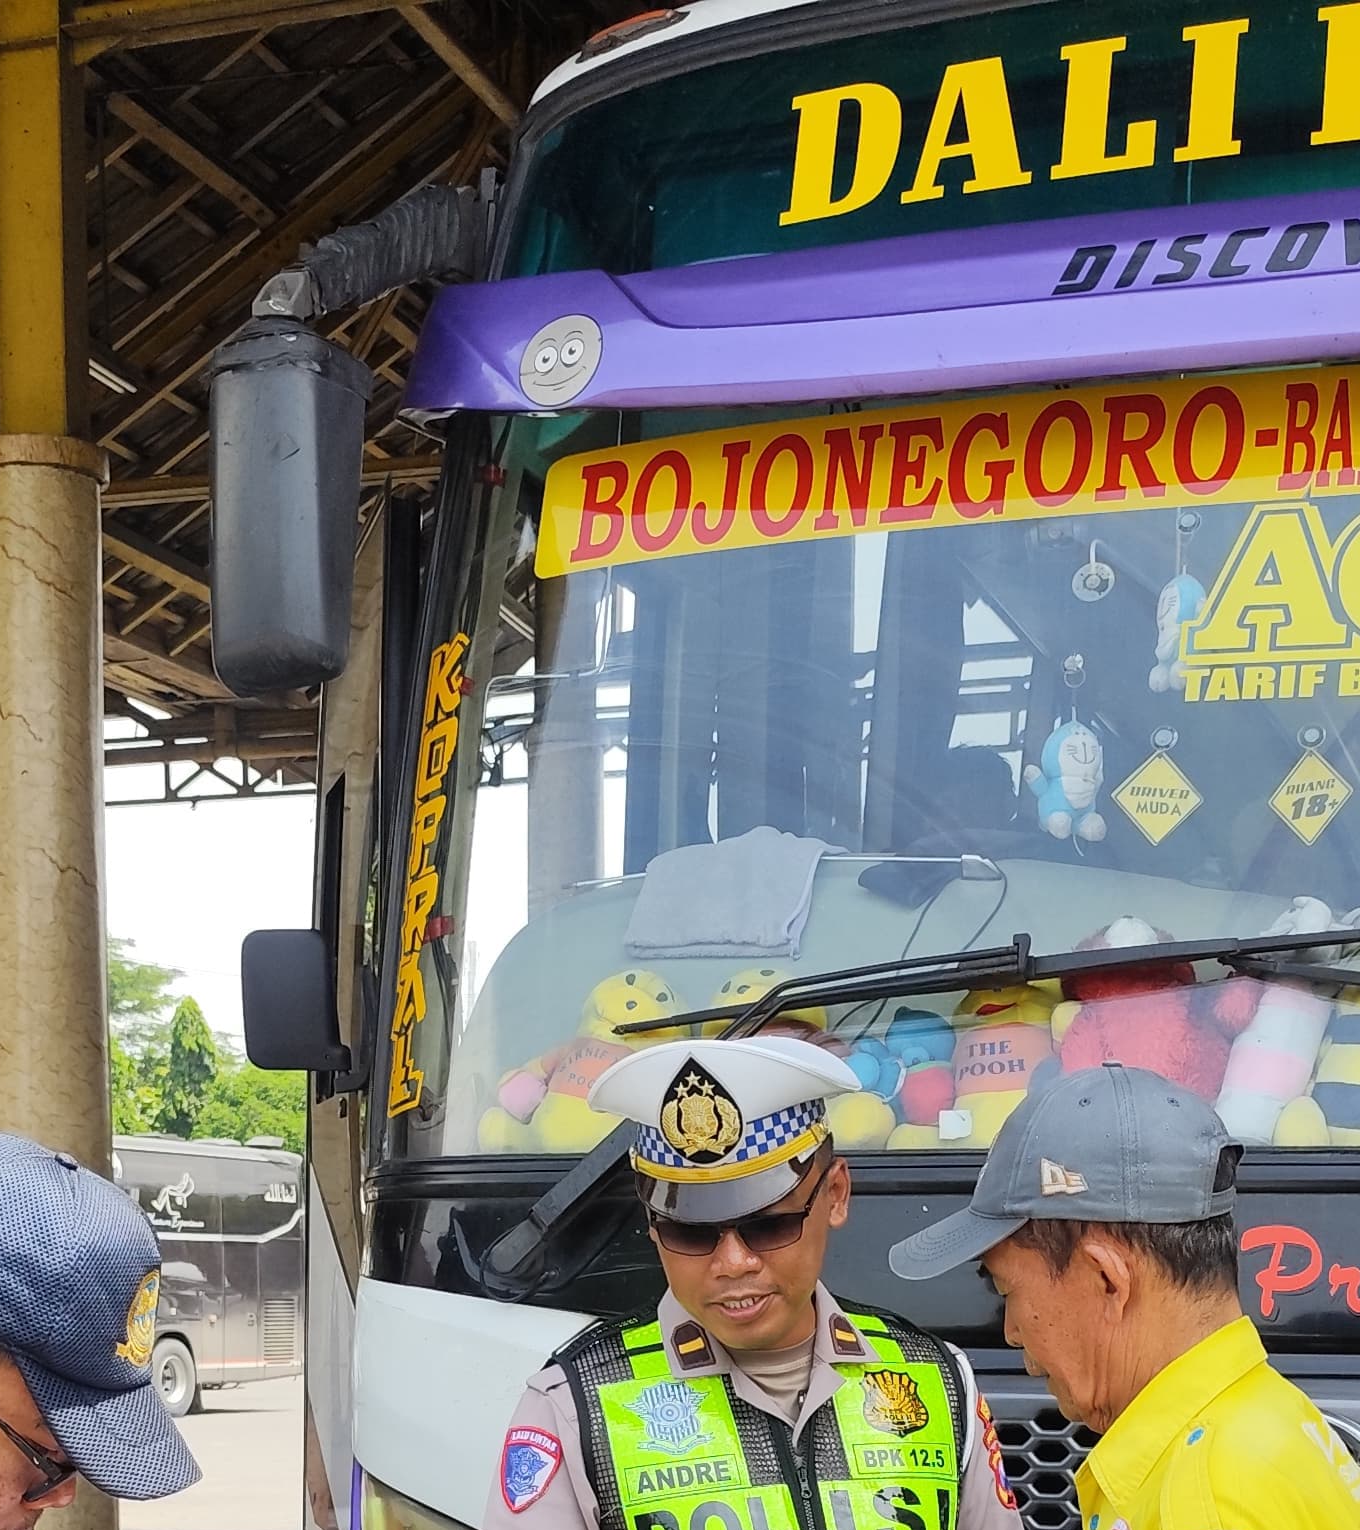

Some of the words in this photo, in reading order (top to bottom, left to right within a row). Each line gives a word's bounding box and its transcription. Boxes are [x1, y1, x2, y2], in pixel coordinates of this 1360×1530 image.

[778, 19, 1249, 226] DALI
[1183, 663, 1327, 702] TARIF
[1129, 786, 1191, 800] DRIVER
[1135, 801, 1182, 816] MUDA
[1290, 793, 1339, 821] 18+
[967, 1040, 1012, 1058] THE
[958, 1059, 1026, 1080] POOH
[863, 1448, 905, 1468] BPK
[637, 1460, 732, 1495] ANDRE
